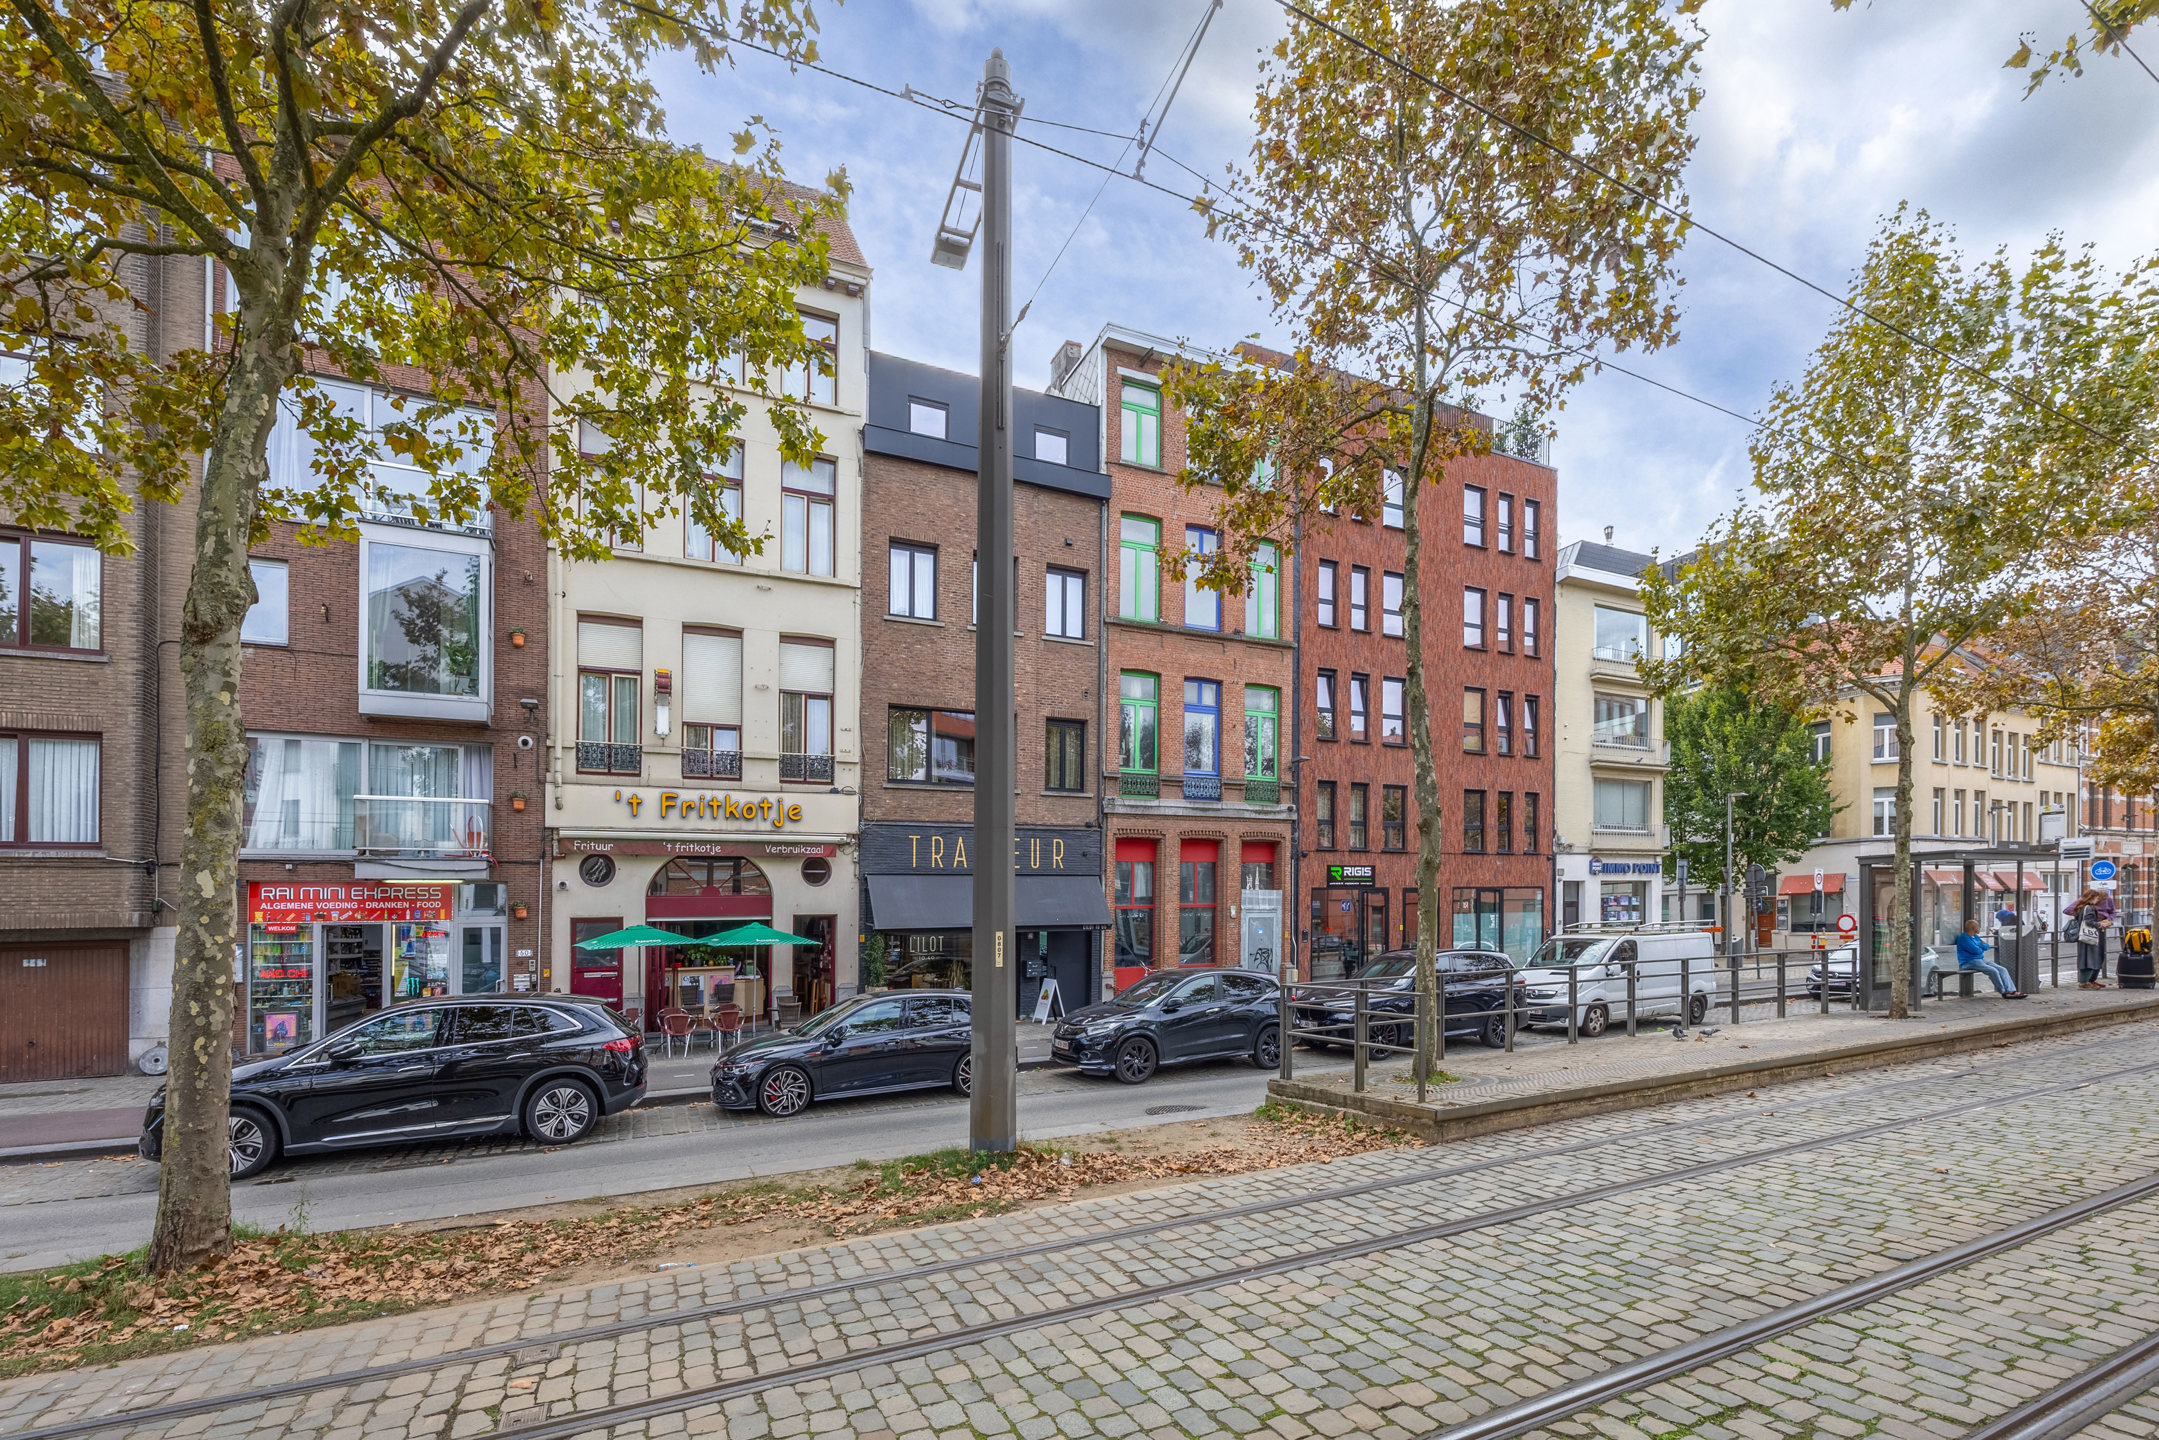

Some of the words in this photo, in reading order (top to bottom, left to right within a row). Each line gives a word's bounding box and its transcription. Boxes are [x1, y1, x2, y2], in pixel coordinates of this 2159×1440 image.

[615, 790, 642, 817] 't
[661, 792, 802, 827] Fritkotje
[573, 840, 614, 851] Frituur
[663, 842, 672, 852] 't
[675, 842, 722, 855] fritkotje
[765, 844, 824, 854] Verbruikzaal
[909, 835, 1064, 869] TRAEUR
[1343, 866, 1372, 876] RIGIS
[1602, 863, 1631, 873] IMMO
[1632, 863, 1662, 873] POINT
[260, 887, 294, 900] RAI
[300, 887, 345, 900] MINI
[260, 902, 314, 910] ALGEMENE
[910, 935, 944, 952] L'ILOT
